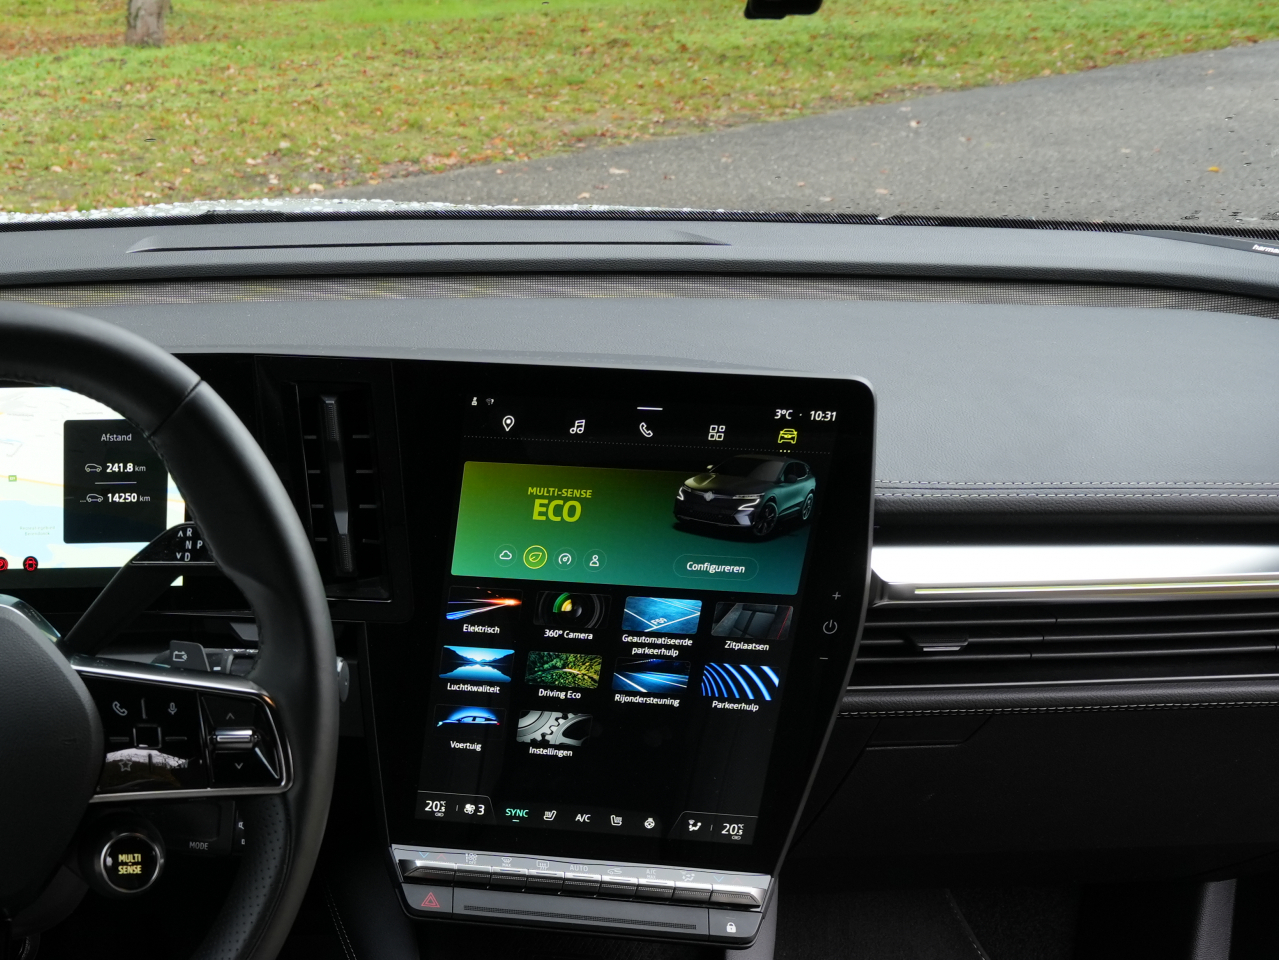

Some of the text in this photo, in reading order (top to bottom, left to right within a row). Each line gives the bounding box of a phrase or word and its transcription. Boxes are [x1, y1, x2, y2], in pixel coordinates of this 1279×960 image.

[809, 410, 837, 421] 10:31
[100, 433, 132, 441] Afstand
[106, 463, 134, 473] 241.8
[527, 486, 593, 498] MULTI-SENSE
[107, 493, 138, 503] 14250
[532, 498, 582, 522] ECO
[186, 527, 193, 537] R
[185, 540, 203, 550] N P
[184, 552, 191, 562] D
[686, 561, 746, 574] Configureren
[462, 624, 500, 634] Elektrisch
[563, 630, 593, 640] Camera
[622, 634, 693, 646] Geautomatiseerde
[724, 641, 770, 651] Zitplaatsen
[631, 646, 679, 657] parkeerhulp
[447, 682, 500, 694] Luchtkwaliteit
[538, 689, 582, 699] Driving Eco
[614, 694, 680, 707] Rijondersteuning
[712, 700, 759, 712] Parkeerhulp
[450, 740, 482, 751] Voertuig
[529, 746, 573, 757] Instellingen
[477, 804, 485, 815] 3
[505, 808, 529, 818] SYNC
[575, 813, 591, 823] A/C
[188, 841, 209, 851] MODE
[118, 853, 142, 863] MULTI
[118, 865, 142, 875] SENSE
[569, 864, 589, 872] AUTO
